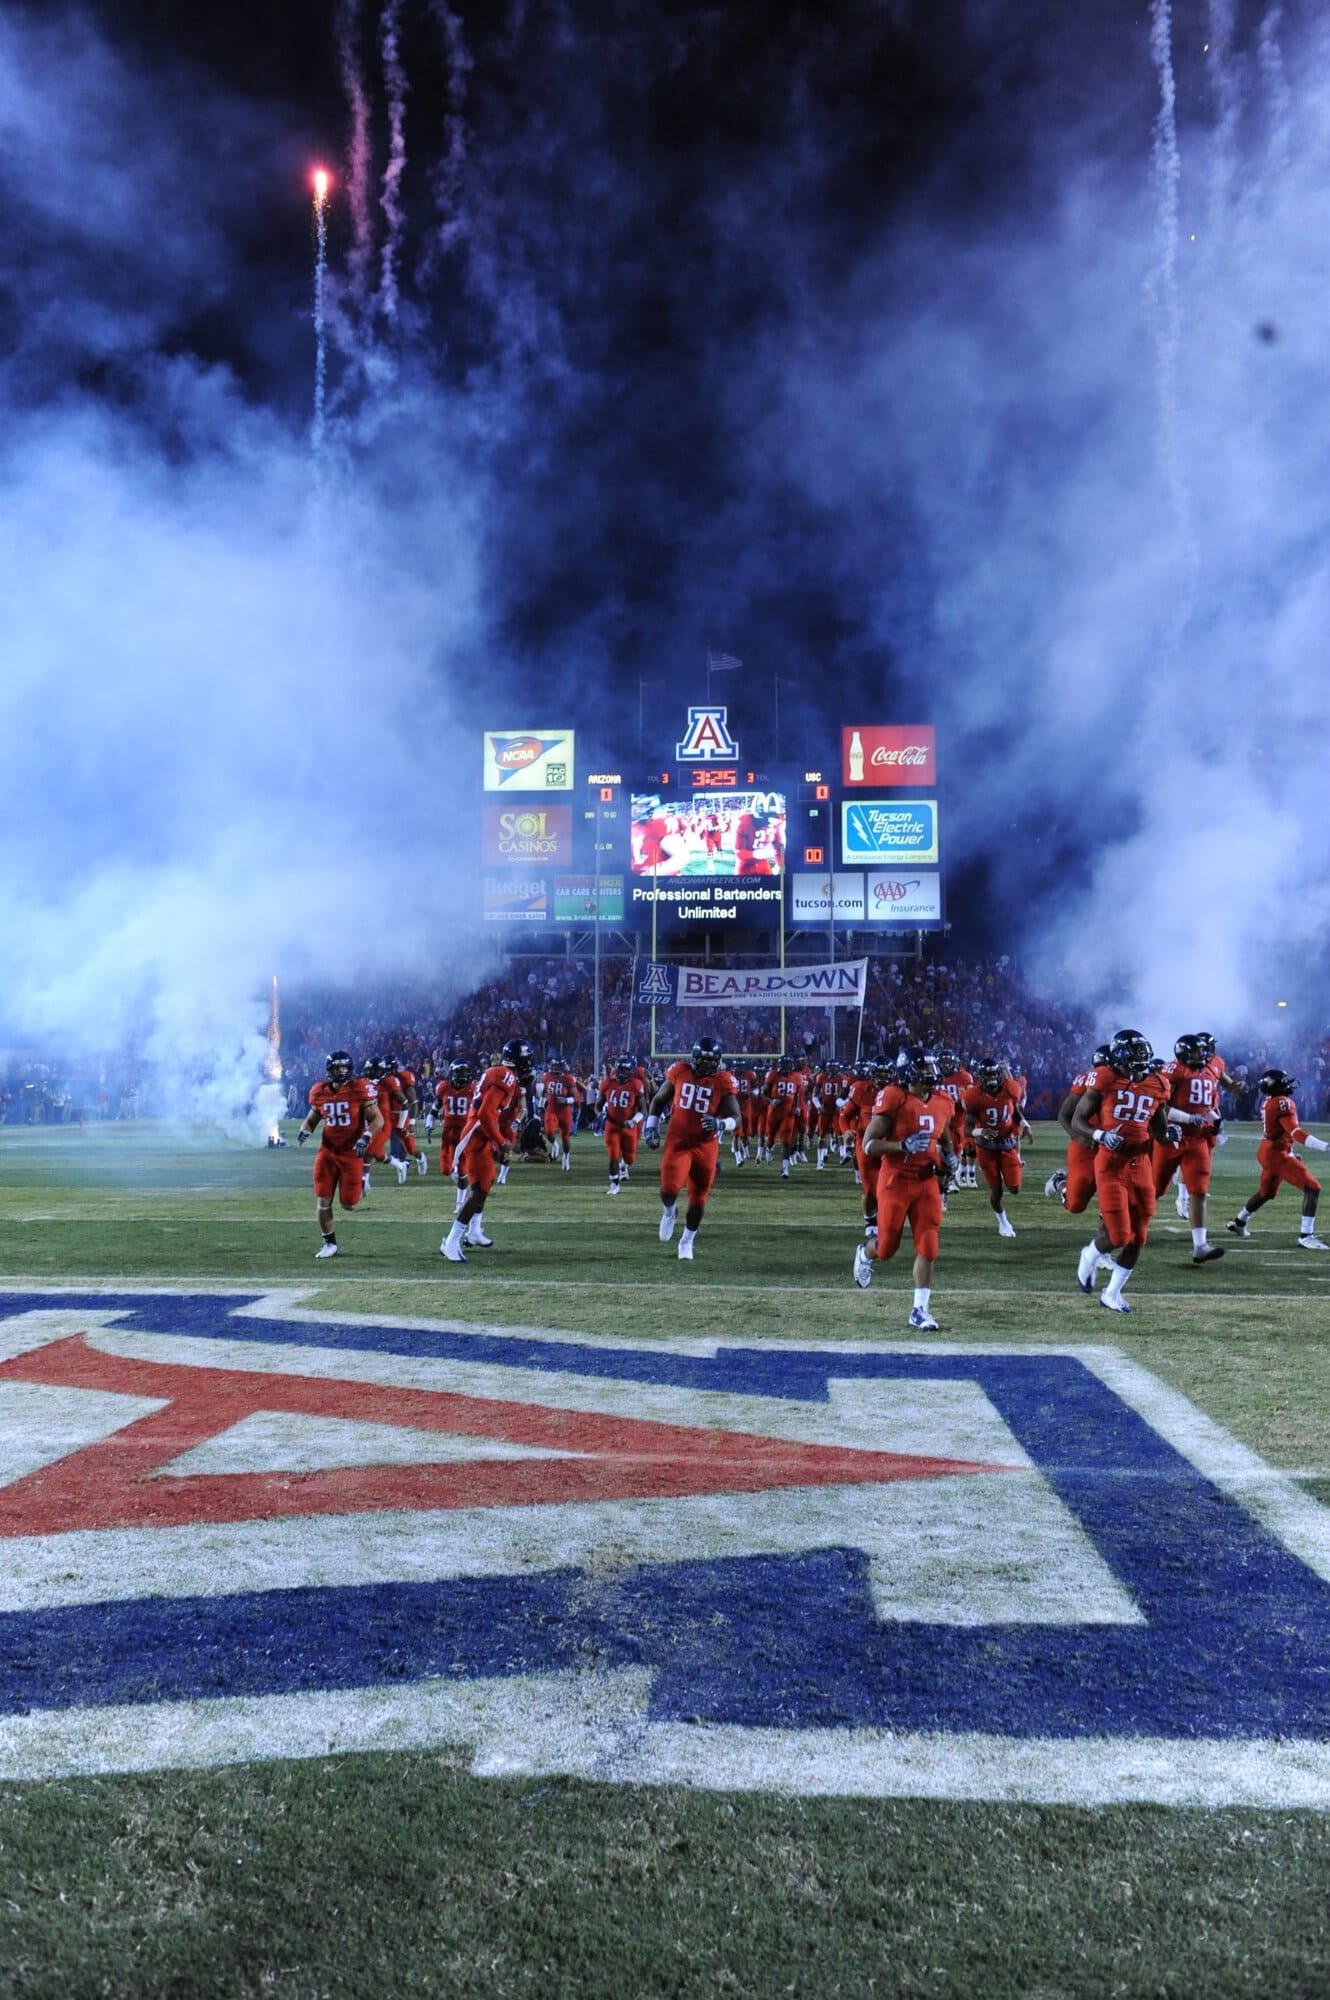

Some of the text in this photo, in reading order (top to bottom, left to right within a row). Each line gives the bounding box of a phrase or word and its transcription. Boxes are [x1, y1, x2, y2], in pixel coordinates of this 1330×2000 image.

[676, 707, 739, 761] A
[502, 749, 535, 762] NCAA
[871, 746, 929, 765] Coca-Cola
[588, 775, 621, 784] ARIZONA
[661, 773, 669, 784] 3
[692, 770, 737, 786] 3:25
[747, 773, 755, 783] 3
[805, 773, 821, 782] USC
[869, 810, 912, 822] Tucson
[499, 812, 557, 840] SOL
[873, 822, 924, 833] Electric
[878, 833, 924, 845] Power
[499, 840, 557, 852] CASINOS
[485, 877, 547, 899] Budget
[556, 888, 622, 896] CAR CARE CNTERS
[633, 888, 782, 900] Professional Bartenders
[876, 881, 903, 901] AAA
[796, 899, 862, 909] tucson.com
[890, 904, 936, 912] Insurance
[678, 906, 736, 918] Unlimited
[501, 1072, 515, 1086] 18
[824, 1083, 839, 1096] 81
[1189, 1078, 1213, 1106] 92
[609, 1090, 630, 1108] 46
[679, 1083, 711, 1114] 95
[447, 1096, 468, 1115] 19
[1113, 1089, 1155, 1123] 26
[323, 1101, 351, 1127] 35
[918, 1115, 935, 1134] 2
